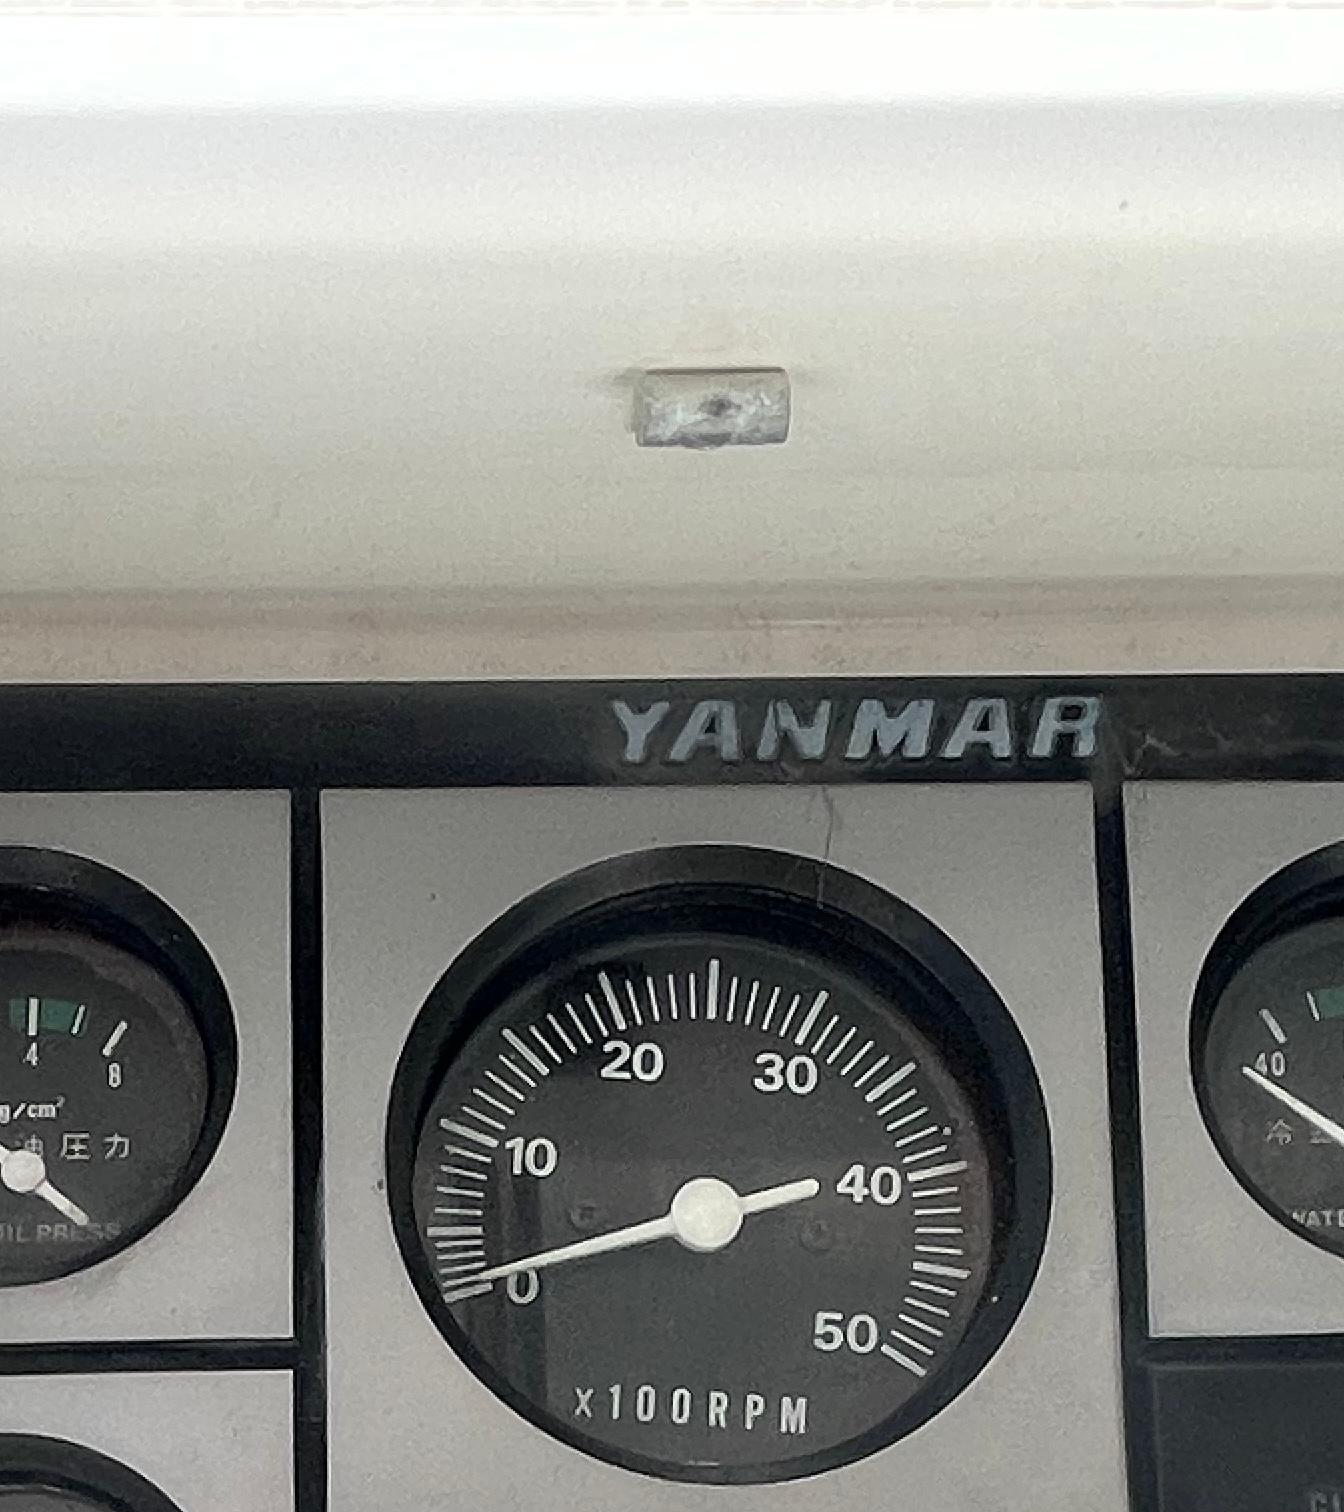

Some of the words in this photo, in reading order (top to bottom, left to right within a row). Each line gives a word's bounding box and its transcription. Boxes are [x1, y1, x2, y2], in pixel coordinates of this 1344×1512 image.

[612, 696, 1103, 763] YANMAR
[23, 1042, 39, 1067] 4
[600, 1041, 664, 1082] 20
[754, 1053, 818, 1094] 30
[1255, 1051, 1286, 1076] 40
[107, 1062, 122, 1088] 8
[506, 1137, 557, 1177] 10
[836, 1165, 902, 1206] 40
[506, 1268, 540, 1304] 0
[813, 1312, 879, 1354] 50
